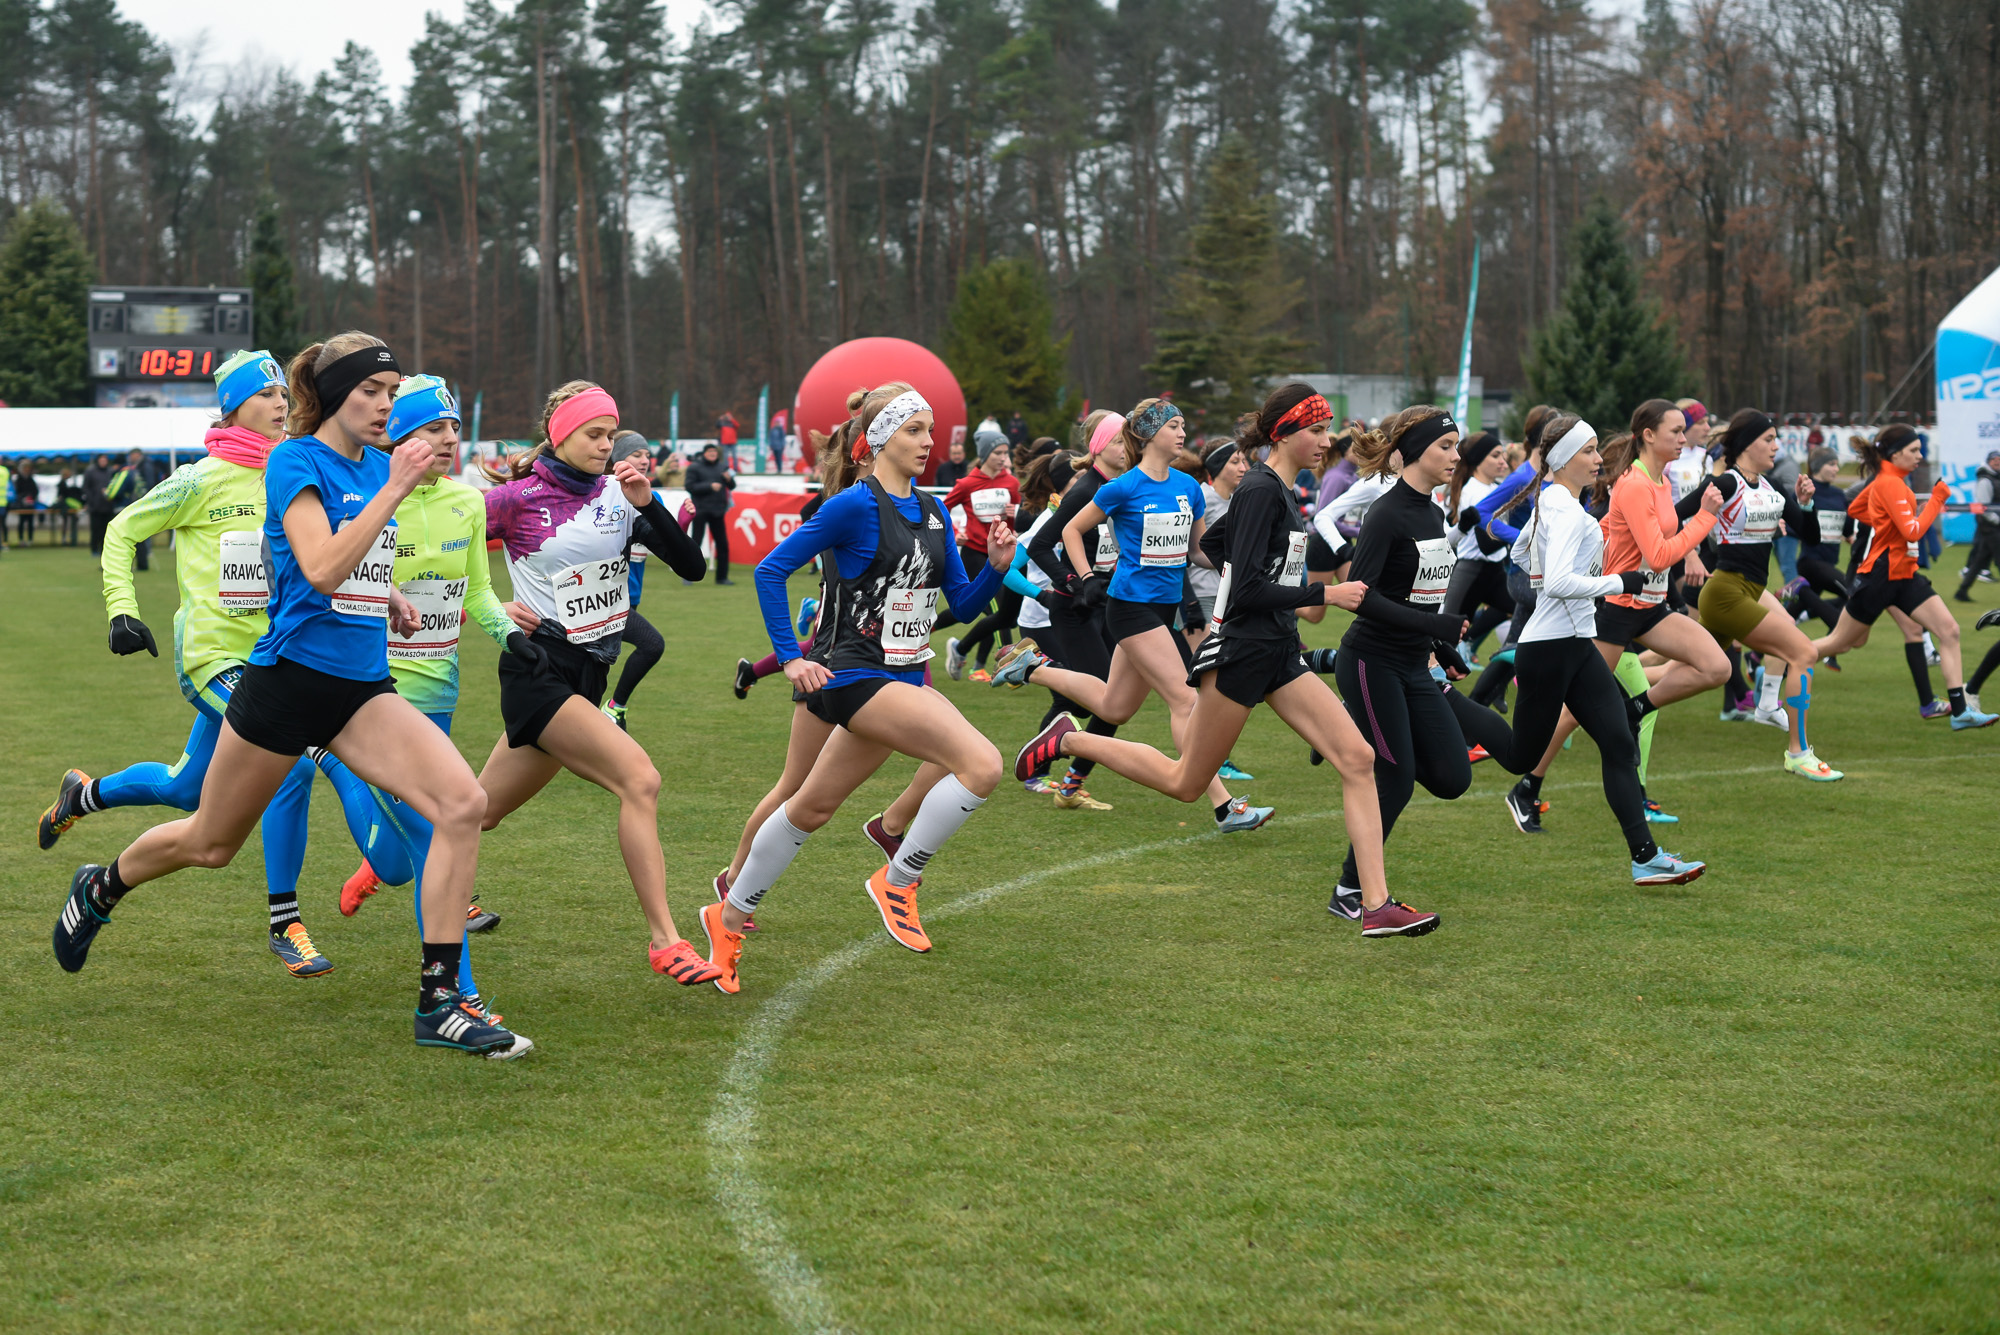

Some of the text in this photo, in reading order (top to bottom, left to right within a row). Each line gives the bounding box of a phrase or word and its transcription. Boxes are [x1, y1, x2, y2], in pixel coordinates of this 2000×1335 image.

[139, 349, 212, 376] 10:31
[1768, 495, 1780, 504] 72
[540, 507, 552, 527] 3
[1174, 514, 1191, 527] 271
[1145, 534, 1188, 547] SKIMINA
[599, 560, 627, 580] 292
[442, 580, 465, 601] 341
[222, 598, 259, 606] TOMASZÓW
[336, 602, 371, 612] TOMASZÓW
[566, 585, 622, 618] STANEK
[388, 649, 427, 658] TOMASZÓW
